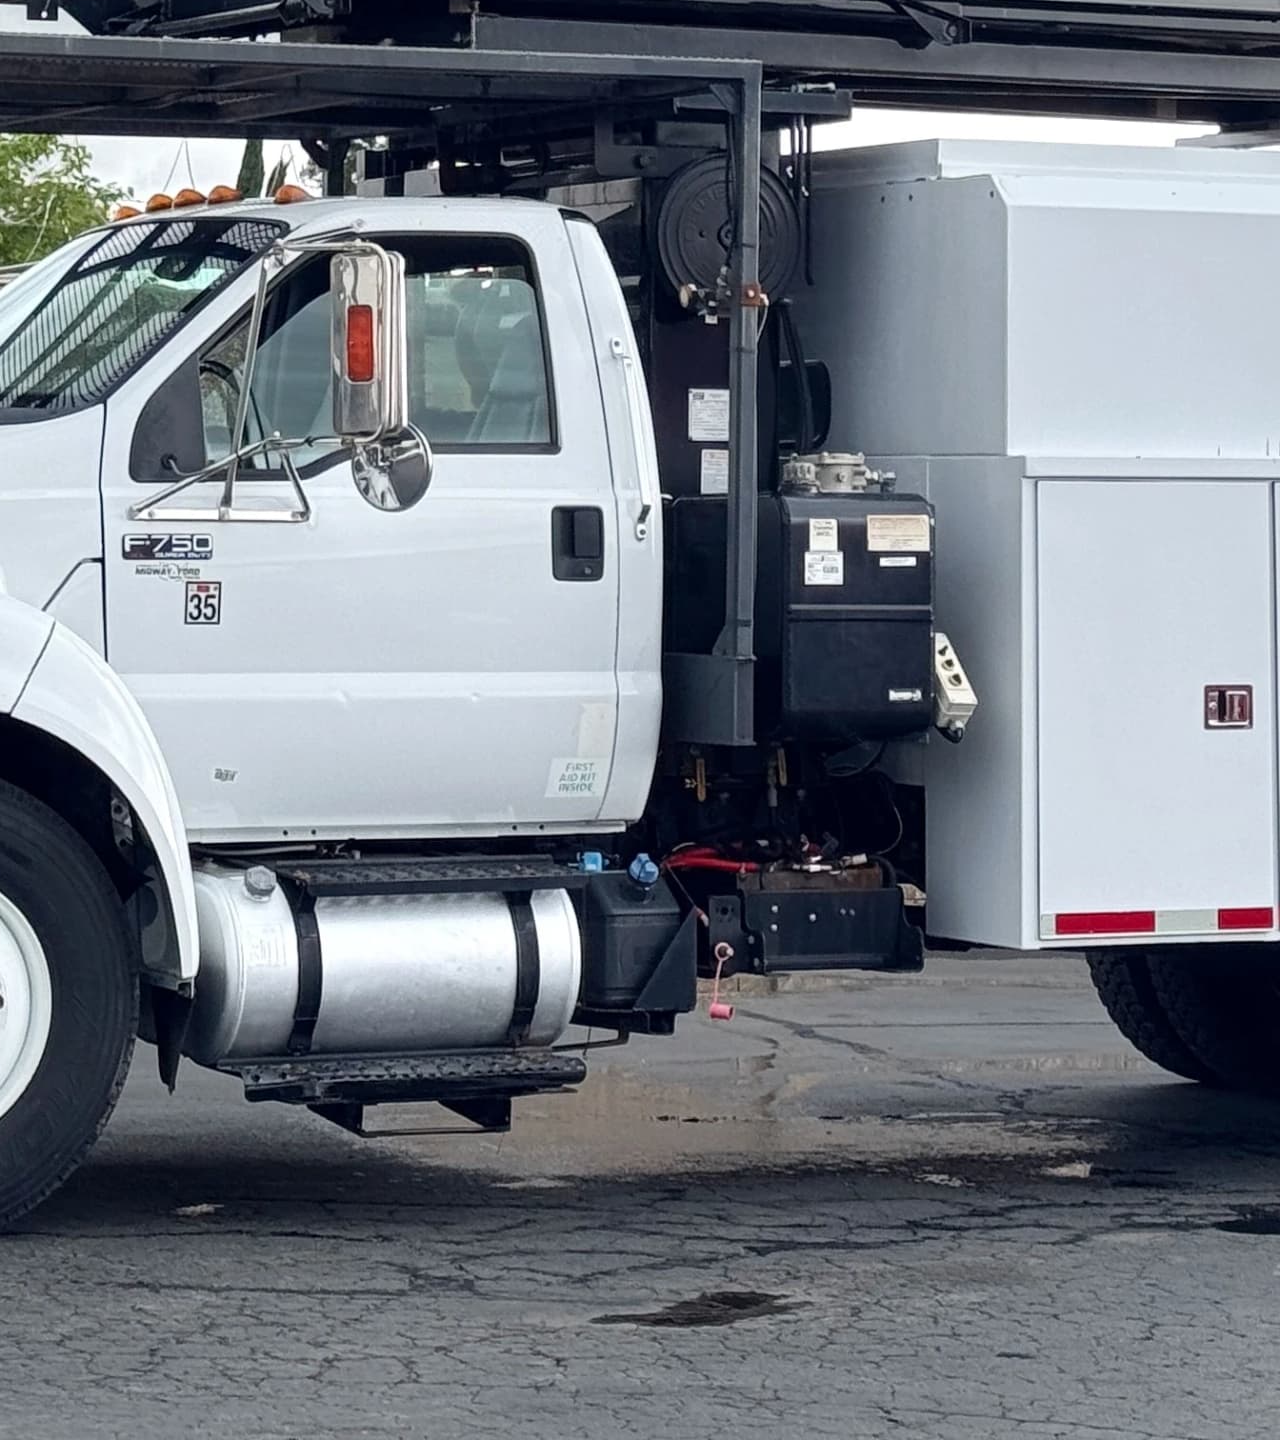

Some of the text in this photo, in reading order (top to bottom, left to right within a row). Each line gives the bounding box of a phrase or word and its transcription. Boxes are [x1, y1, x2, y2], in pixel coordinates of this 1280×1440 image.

[188, 593, 217, 621] 35
[565, 762, 595, 772] FIRST
[558, 772, 596, 782] AID KIT
[558, 781, 594, 793] INSIDE
